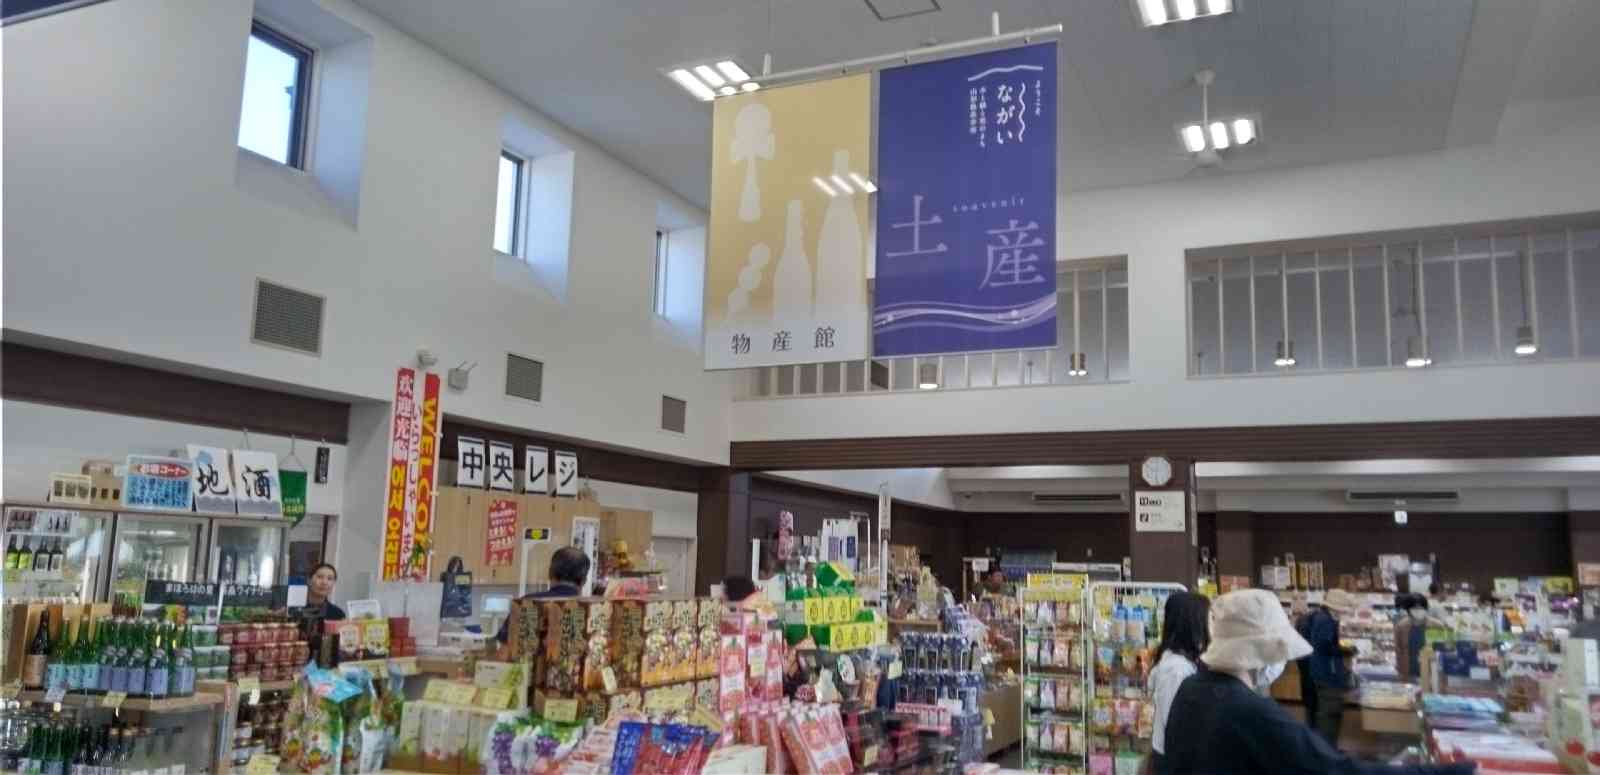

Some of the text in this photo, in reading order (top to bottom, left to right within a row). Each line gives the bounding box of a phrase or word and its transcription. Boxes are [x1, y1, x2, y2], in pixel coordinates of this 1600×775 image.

[996, 84, 1016, 145] ながい
[953, 197, 1025, 212] souvenir
[885, 194, 1046, 291] 土産
[731, 326, 835, 355] 物産館
[197, 463, 271, 500] 地酒
[389, 464, 406, 511] 어서
[414, 399, 437, 562] WELCO
[463, 447, 575, 487] 中央レジ
